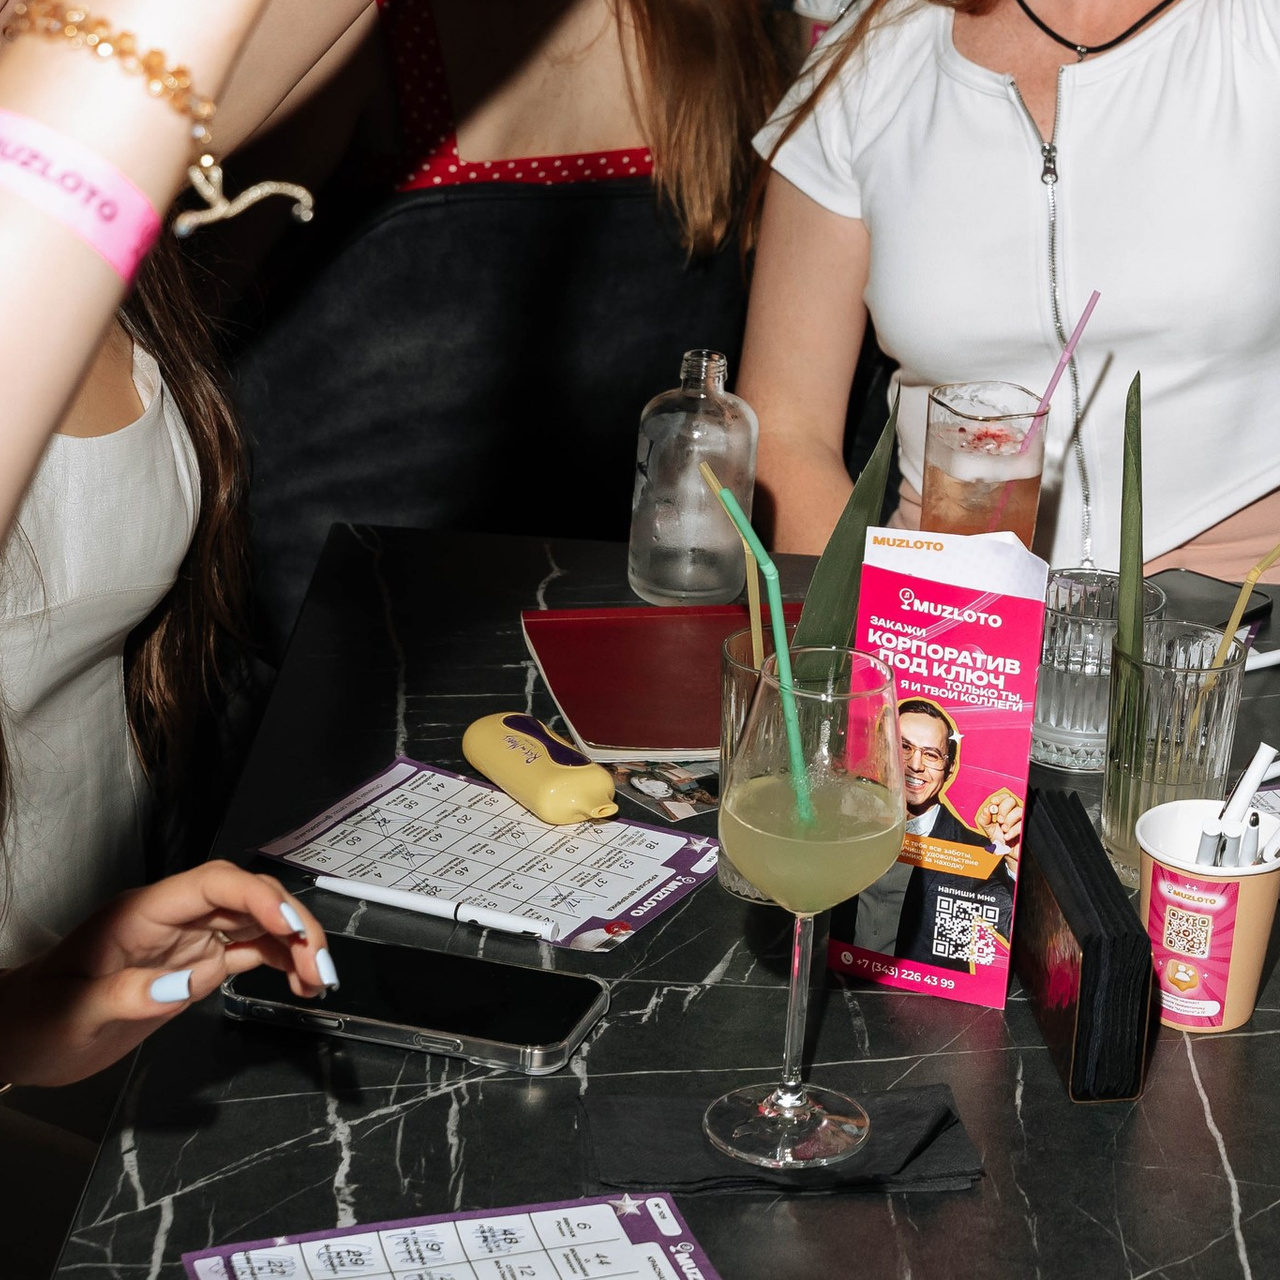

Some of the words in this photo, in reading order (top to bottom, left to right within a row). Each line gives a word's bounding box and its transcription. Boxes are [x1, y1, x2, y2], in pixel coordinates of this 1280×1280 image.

[0, 139, 118, 222] UZLOTO
[872, 535, 944, 551] MUZLOTO
[913, 598, 1003, 628] MUZLOTO
[870, 616, 927, 637] ЗАКАЖИ
[868, 628, 1021, 675] КОРПОРАТИВ
[879, 649, 928, 677] ПОД
[933, 662, 1005, 689] КЛЮЧ
[901, 680, 910, 689] Я
[911, 683, 921, 691] И
[960, 691, 1023, 712] КОЛЛЕГИ
[945, 680, 998, 698] ТОЛЬКО
[1000, 690, 1023, 703] ТЫ,
[432, 783, 444, 791] 44
[404, 800, 418, 809] 56
[484, 797, 498, 806] 35
[457, 814, 471, 824] 20
[429, 833, 442, 842] 40
[511, 830, 524, 838] 10
[346, 837, 361, 846] 60
[645, 841, 659, 849] 18
[565, 845, 579, 853] 19
[317, 855, 331, 863] 16
[619, 859, 634, 869] 53
[455, 867, 468, 875] 46
[538, 863, 552, 872] 24
[594, 878, 607, 887] 37
[630, 880, 681, 916] MUZLOTO
[938, 885, 975, 899] напиши
[977, 893, 996, 903] мне
[1173, 890, 1216, 905] MUZLOTO
[565, 899, 580, 907] 17
[856, 959, 868, 968] +7
[872, 962, 899, 978] (343)
[901, 969, 922, 982] 226
[923, 974, 938, 985] 43
[940, 978, 955, 989] 99
[576, 1222, 592, 1230] 6
[594, 1252, 612, 1266] 44
[517, 1265, 537, 1278] 12
